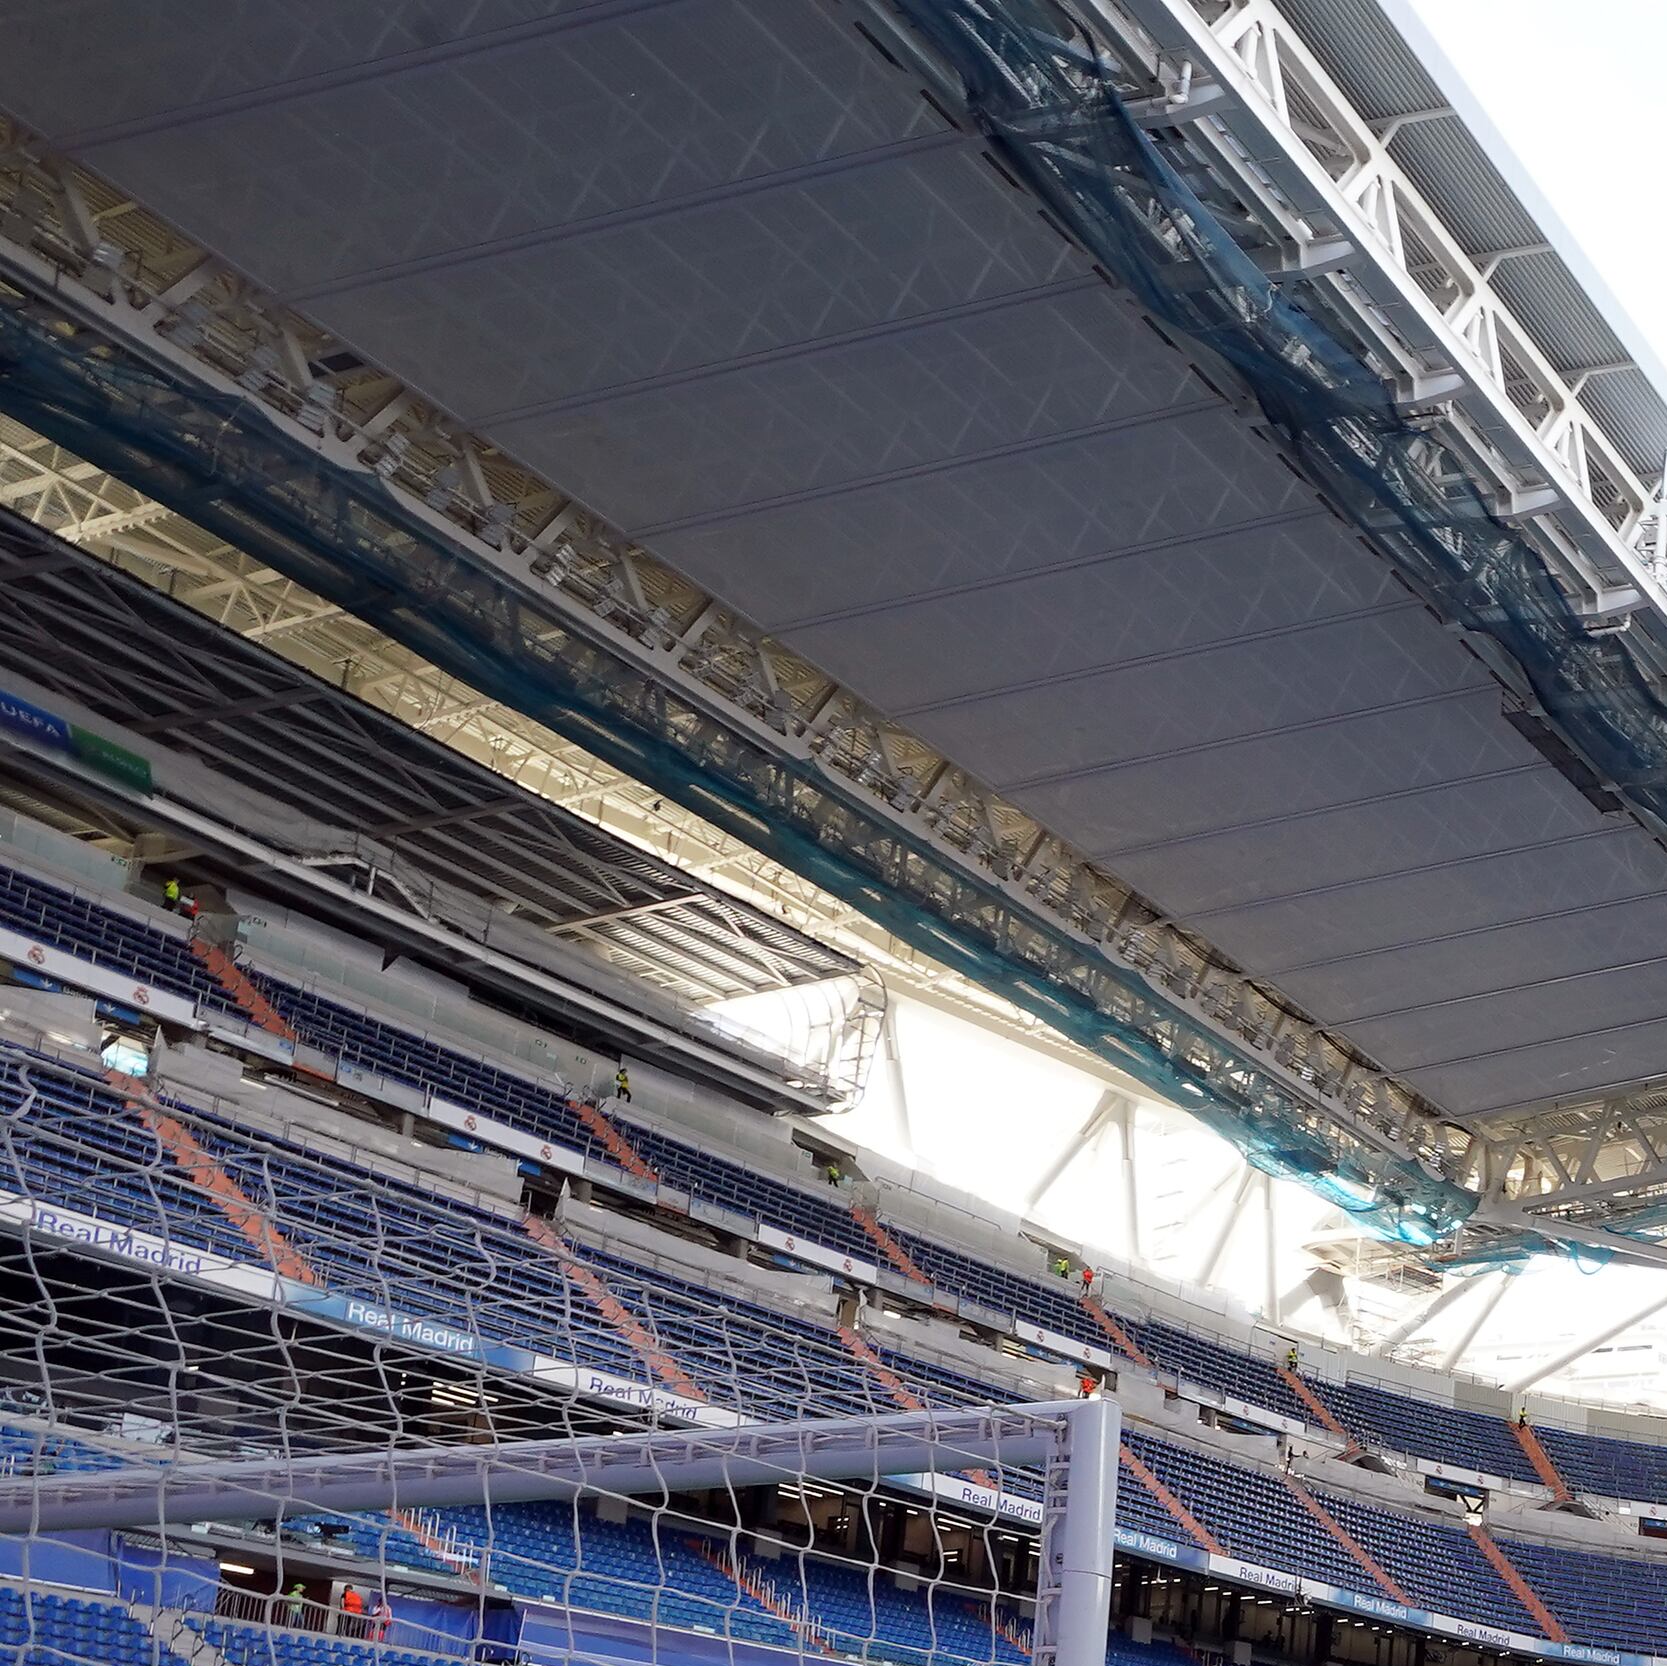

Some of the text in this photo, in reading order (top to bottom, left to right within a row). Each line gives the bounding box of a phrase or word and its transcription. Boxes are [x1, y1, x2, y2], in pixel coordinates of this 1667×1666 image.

[37, 1209, 201, 1275] Real Madrid
[348, 1300, 474, 1353] Real Madrid
[589, 1376, 632, 1402] Real
[962, 1487, 1041, 1521] Real Madrid
[1113, 1528, 1177, 1558] Real Madrid
[1239, 1567, 1302, 1593] Real Madri
[1354, 1595, 1407, 1620] Real Madrid
[1457, 1624, 1510, 1646] Real Madrid
[1563, 1645, 1620, 1665] Real Madrid
